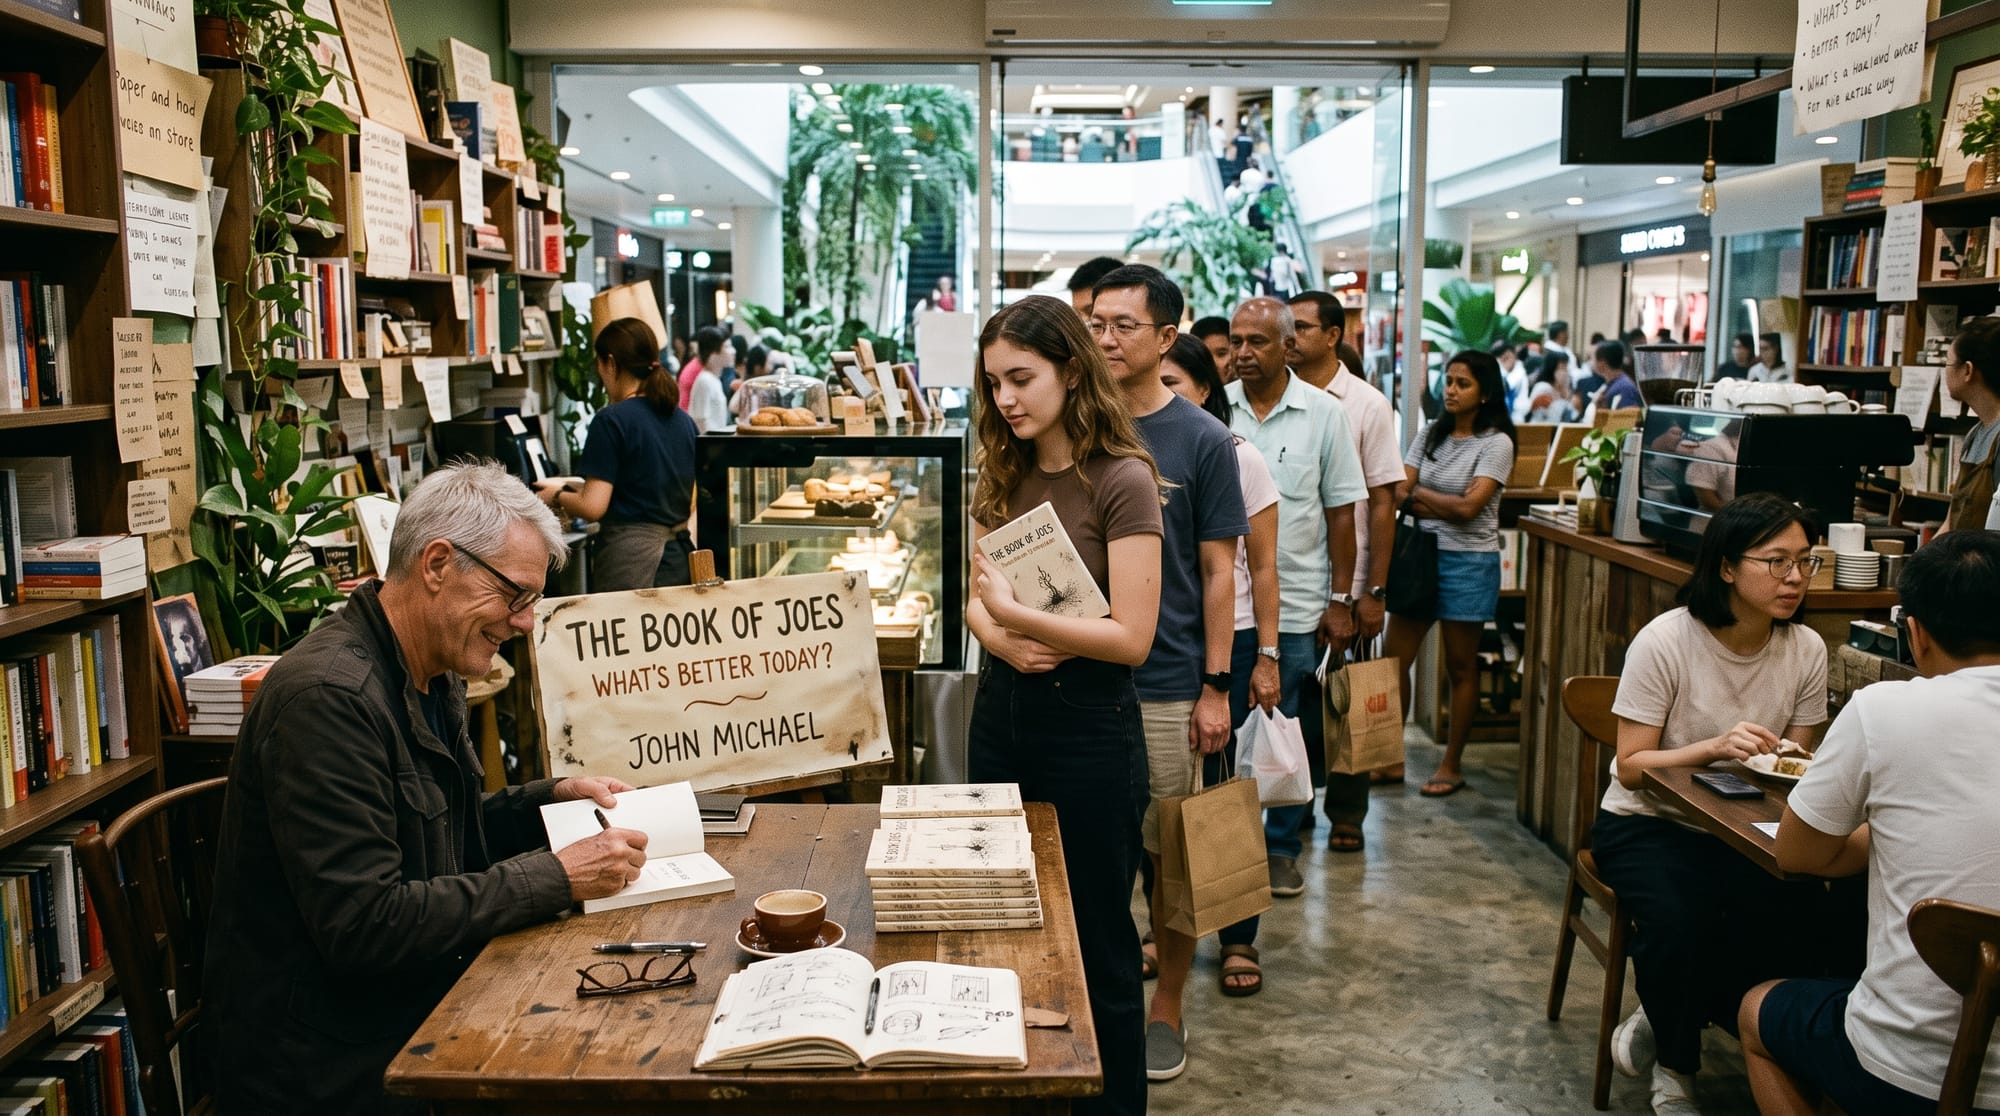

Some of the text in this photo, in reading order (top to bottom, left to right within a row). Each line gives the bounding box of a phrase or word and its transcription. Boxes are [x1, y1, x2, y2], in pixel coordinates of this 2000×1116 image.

[1846, 13, 1881, 46] TODAY?
[151, 90, 170, 109] and
[989, 548, 1006, 562] THE
[1003, 537, 1025, 556] BOOK
[1025, 532, 1034, 544] OF
[1035, 522, 1054, 541] JOES
[565, 593, 844, 661] THE BOOK OF JOES
[592, 641, 834, 698] WHAT'S BETTER TODAY?
[628, 711, 825, 770] JOHN MICHAEL
